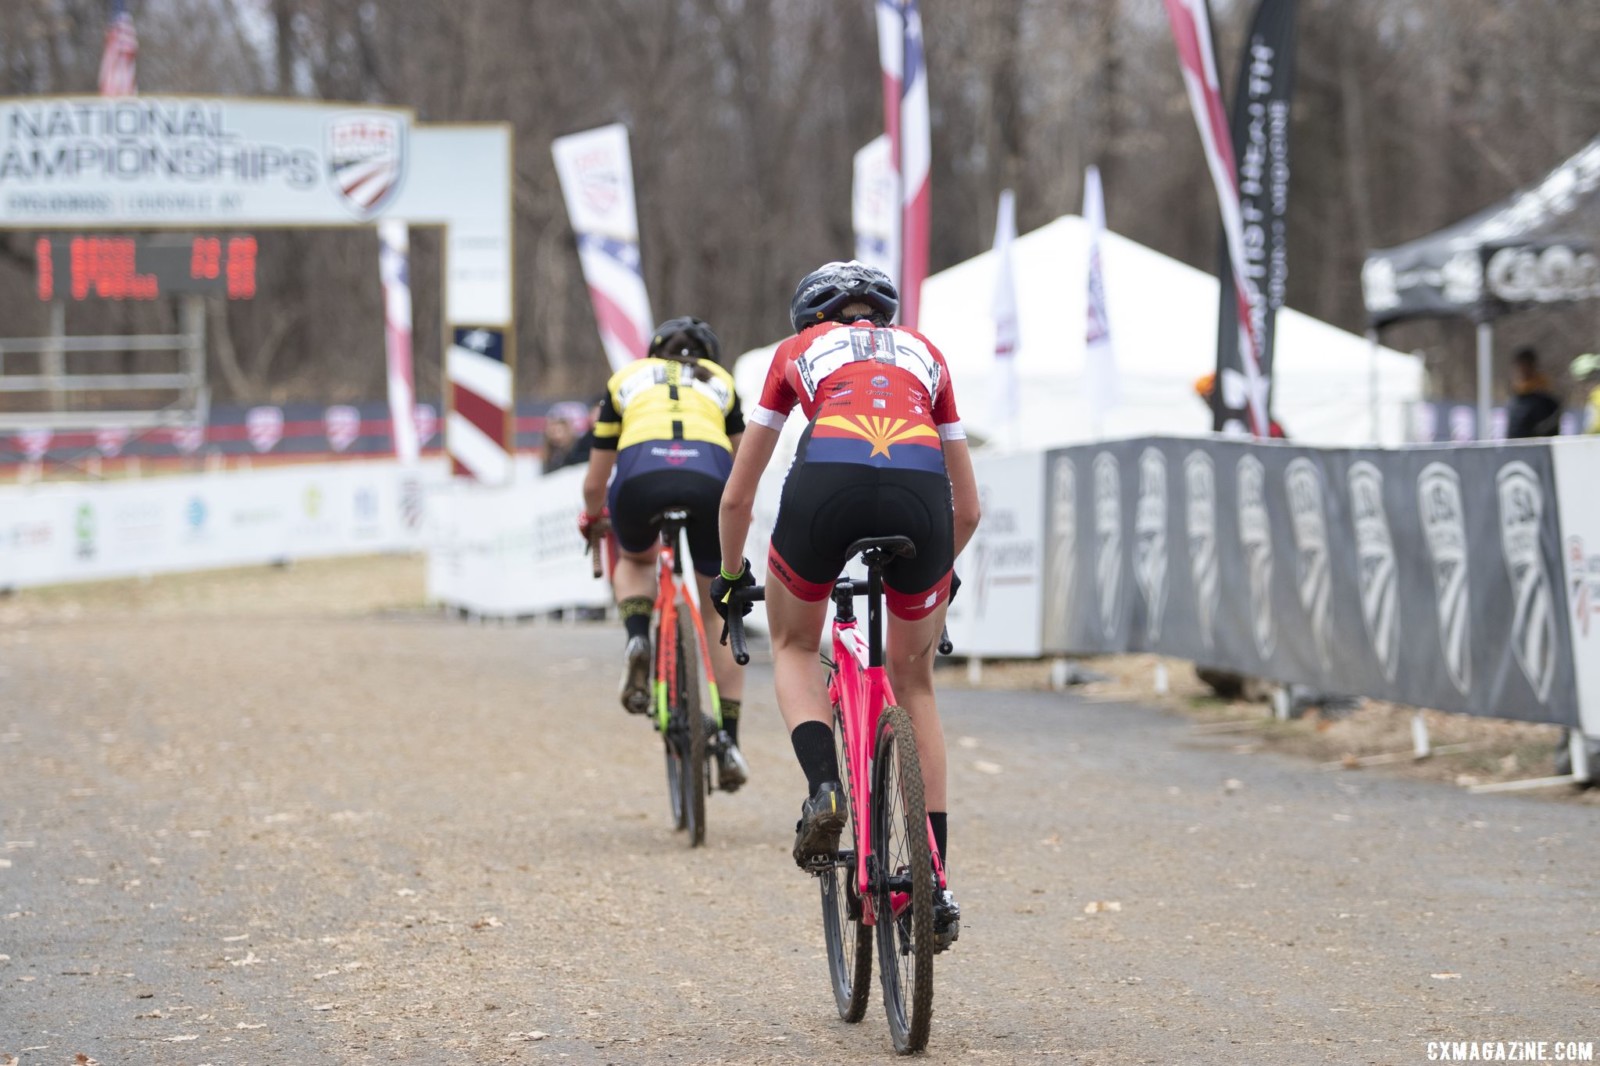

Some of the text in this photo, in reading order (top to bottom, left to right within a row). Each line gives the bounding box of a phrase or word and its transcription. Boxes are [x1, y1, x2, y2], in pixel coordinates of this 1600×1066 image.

[8, 103, 240, 140] NATIONAL
[1241, 45, 1275, 356] APTIST HEALTH
